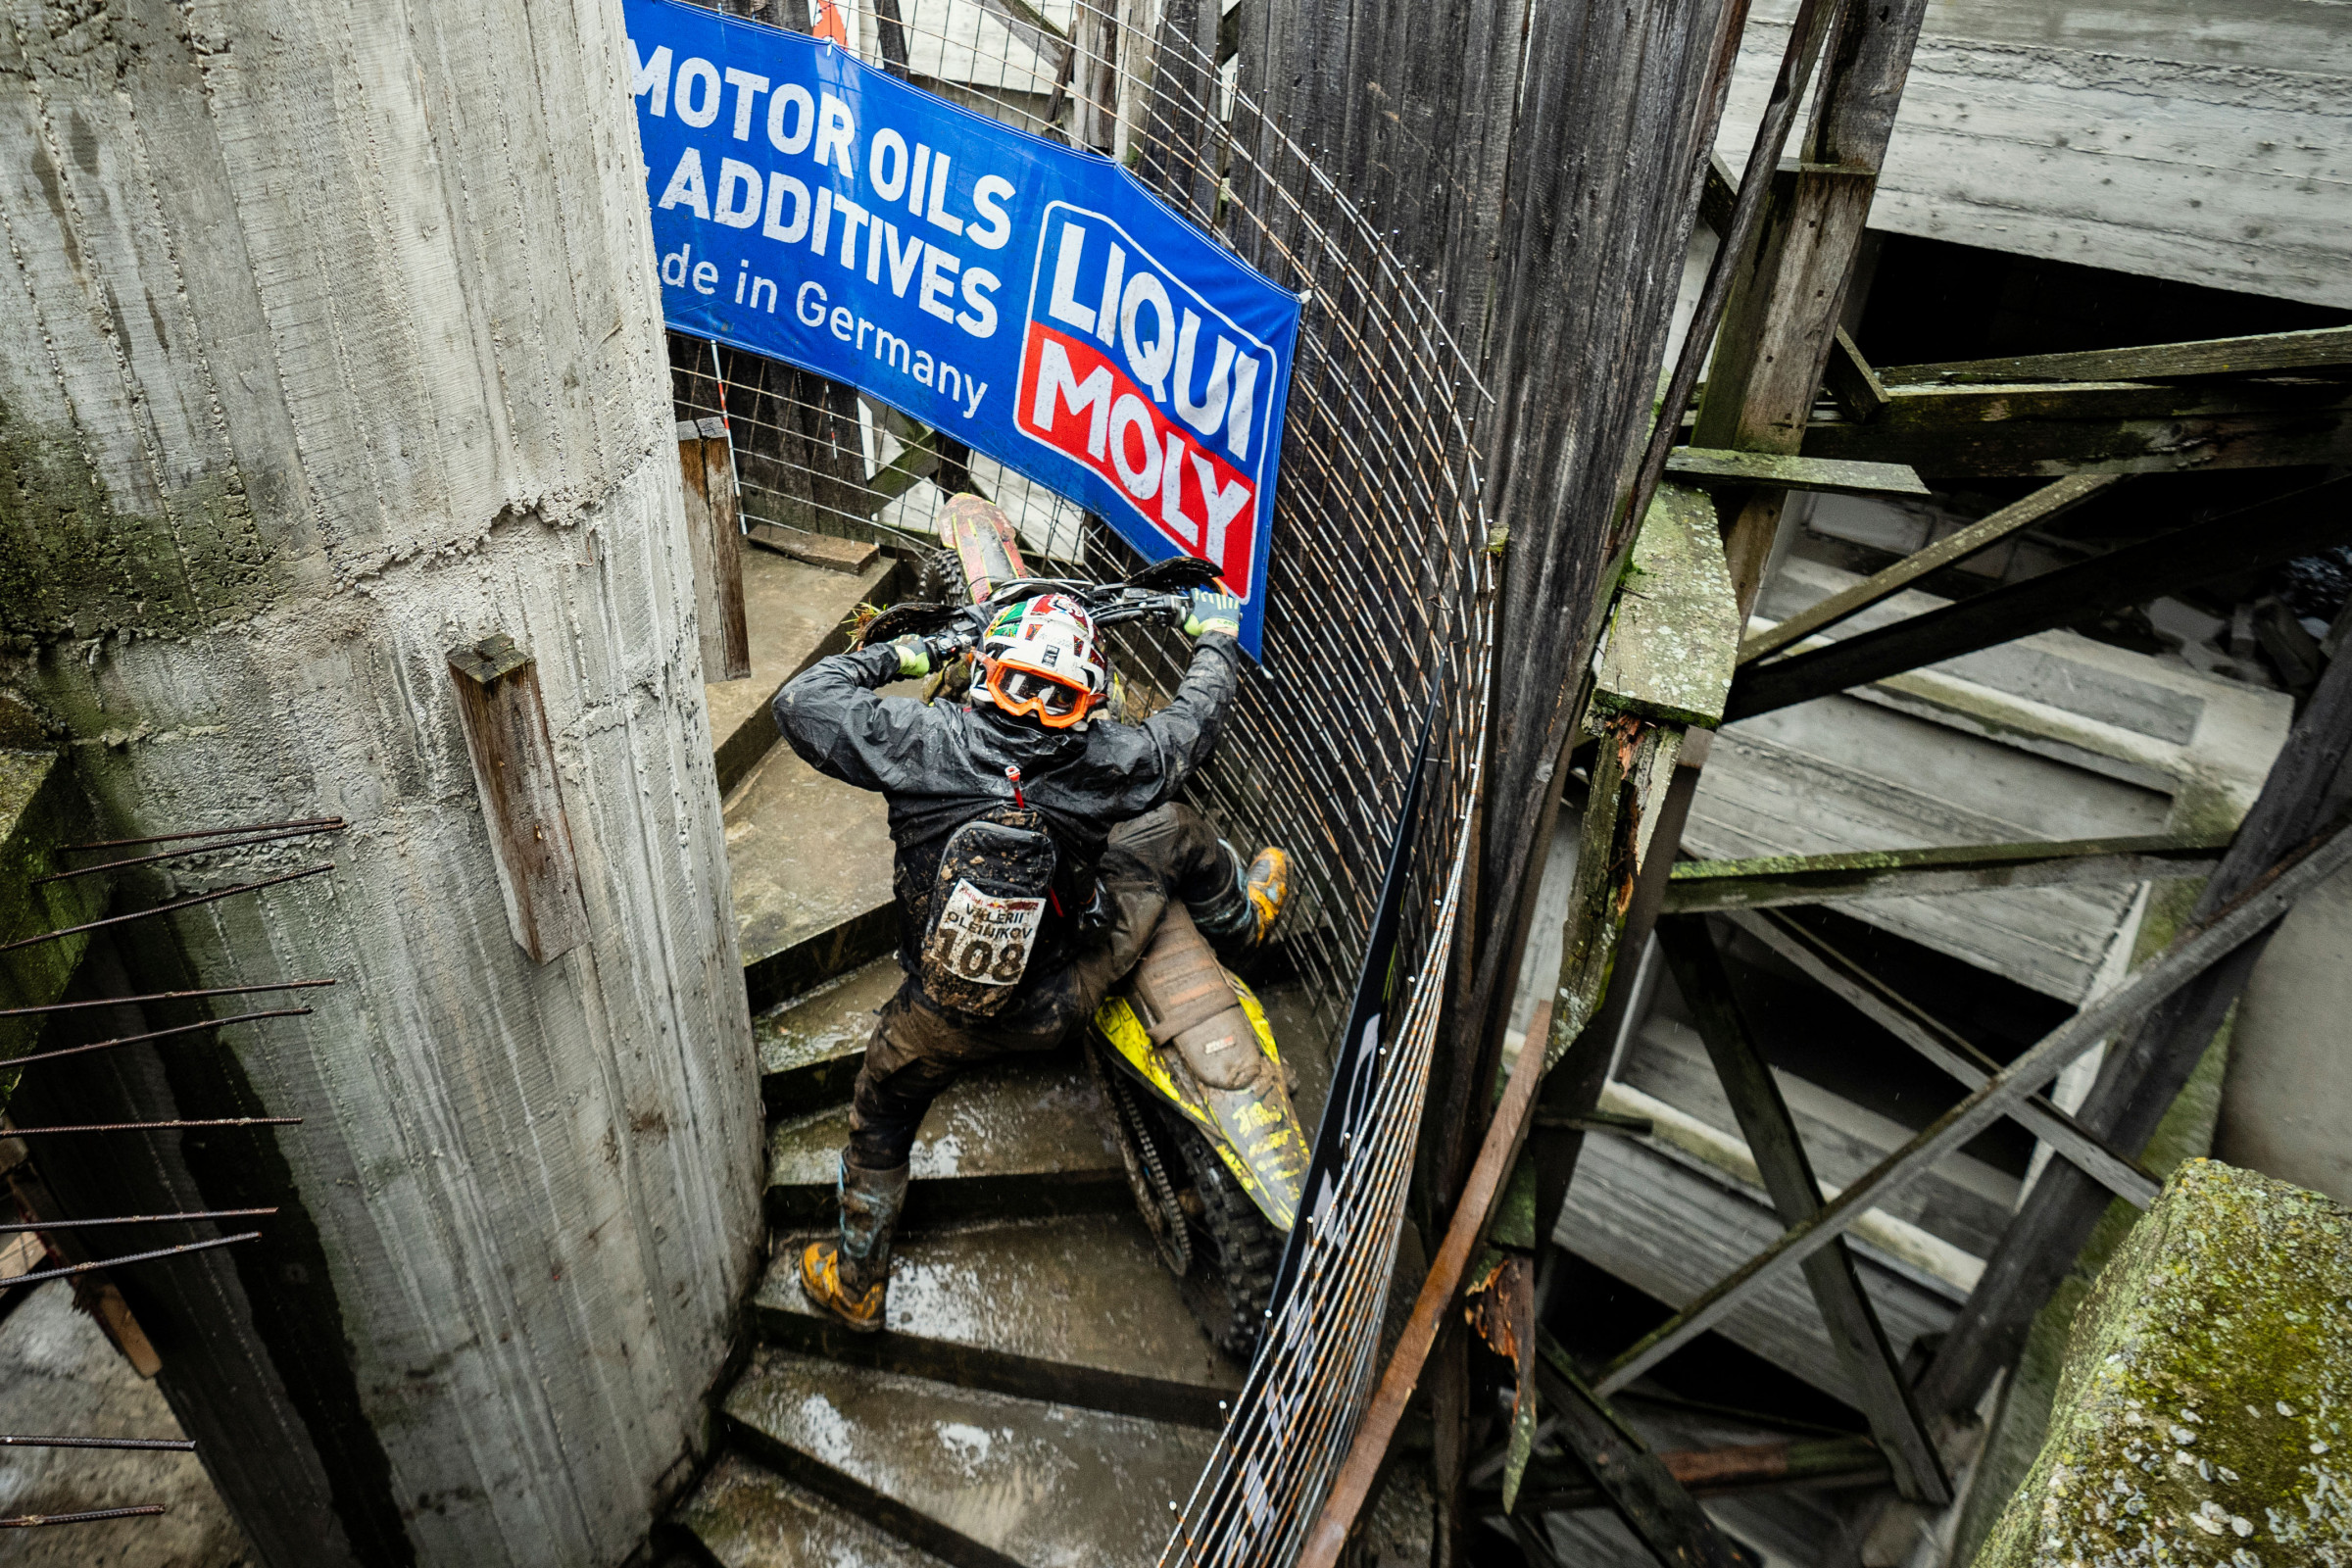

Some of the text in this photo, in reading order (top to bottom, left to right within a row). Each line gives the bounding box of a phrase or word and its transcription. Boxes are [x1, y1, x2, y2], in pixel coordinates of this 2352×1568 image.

[626, 37, 1017, 251] MOTOR OILS
[657, 146, 1004, 339] ADDITIVES
[660, 242, 989, 421] de in Germany
[1047, 221, 1261, 462] LIQUI
[1032, 339, 1252, 570] MOLY
[938, 928, 1025, 982] 108
[966, 903, 1024, 924] VLERII
